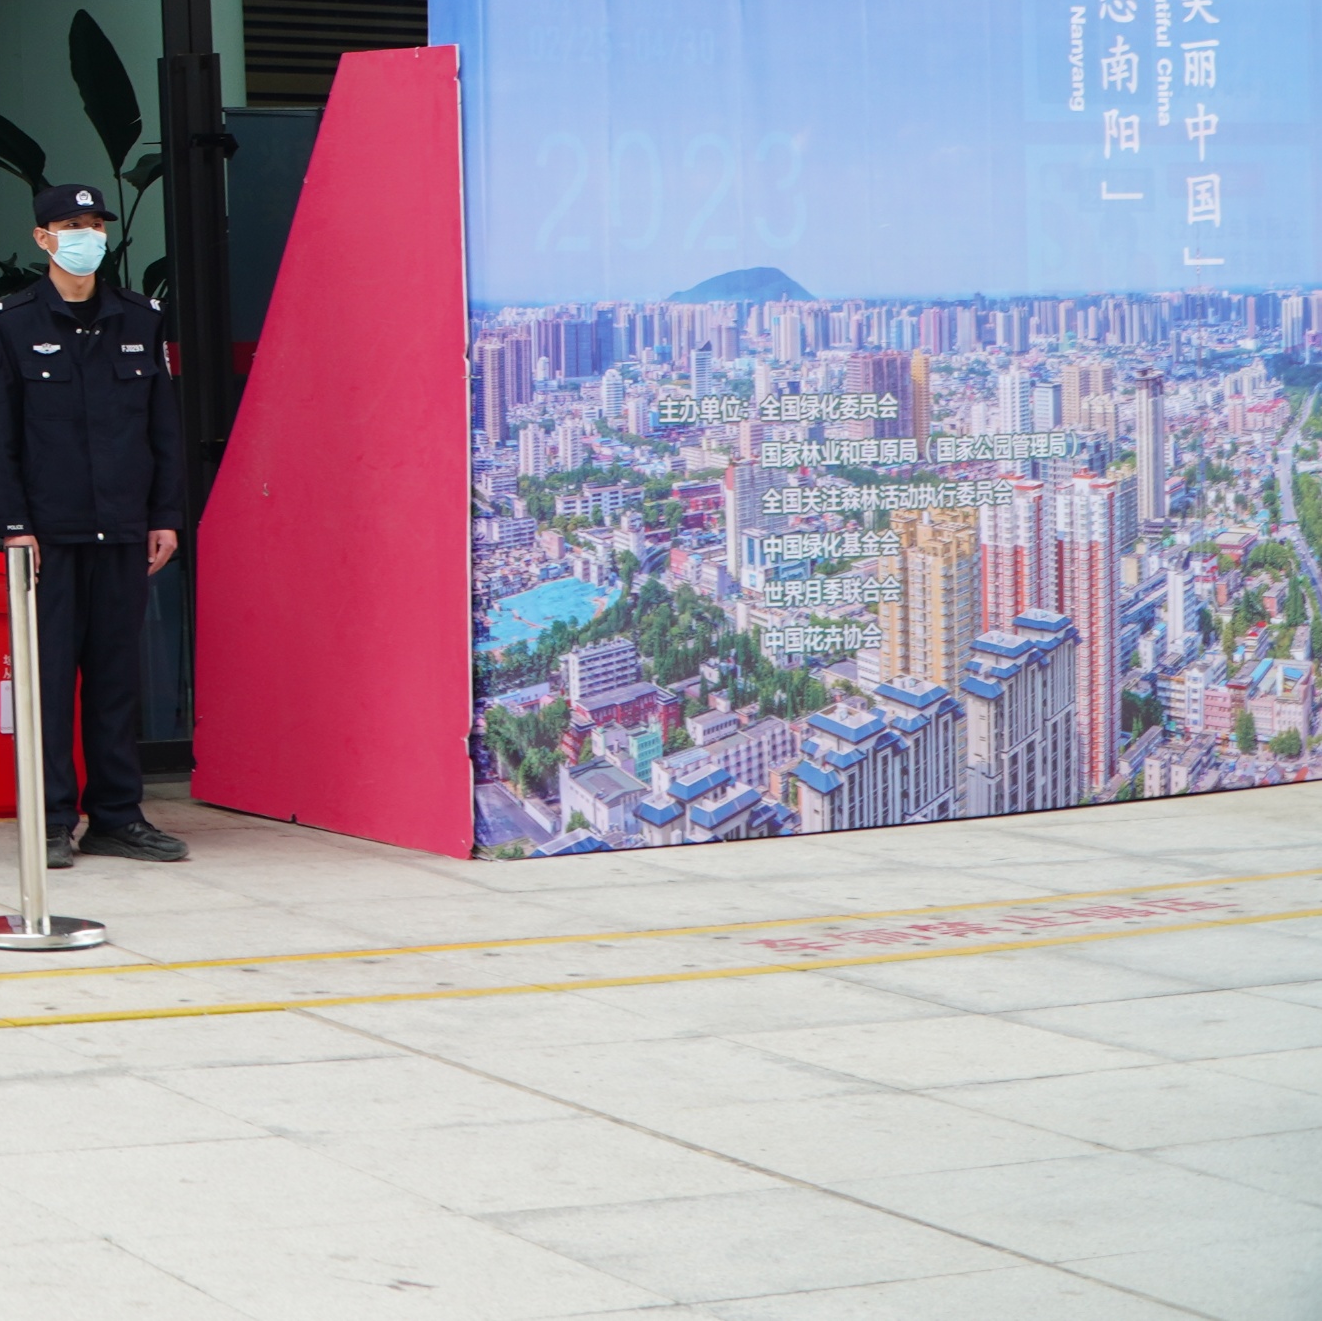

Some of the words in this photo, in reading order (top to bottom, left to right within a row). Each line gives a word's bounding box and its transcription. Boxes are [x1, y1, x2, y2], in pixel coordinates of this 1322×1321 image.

[1069, 6, 1086, 112] Nanyang
[1157, 59, 1172, 127] China
[760, 392, 899, 422] 全国绿化委员会
[762, 479, 1014, 515] 全国关注森林活动执行委员会
[762, 529, 900, 563] 中国绿化基金会
[763, 577, 901, 608] 世界月季联合会
[764, 623, 883, 655] 中国花卉协会
